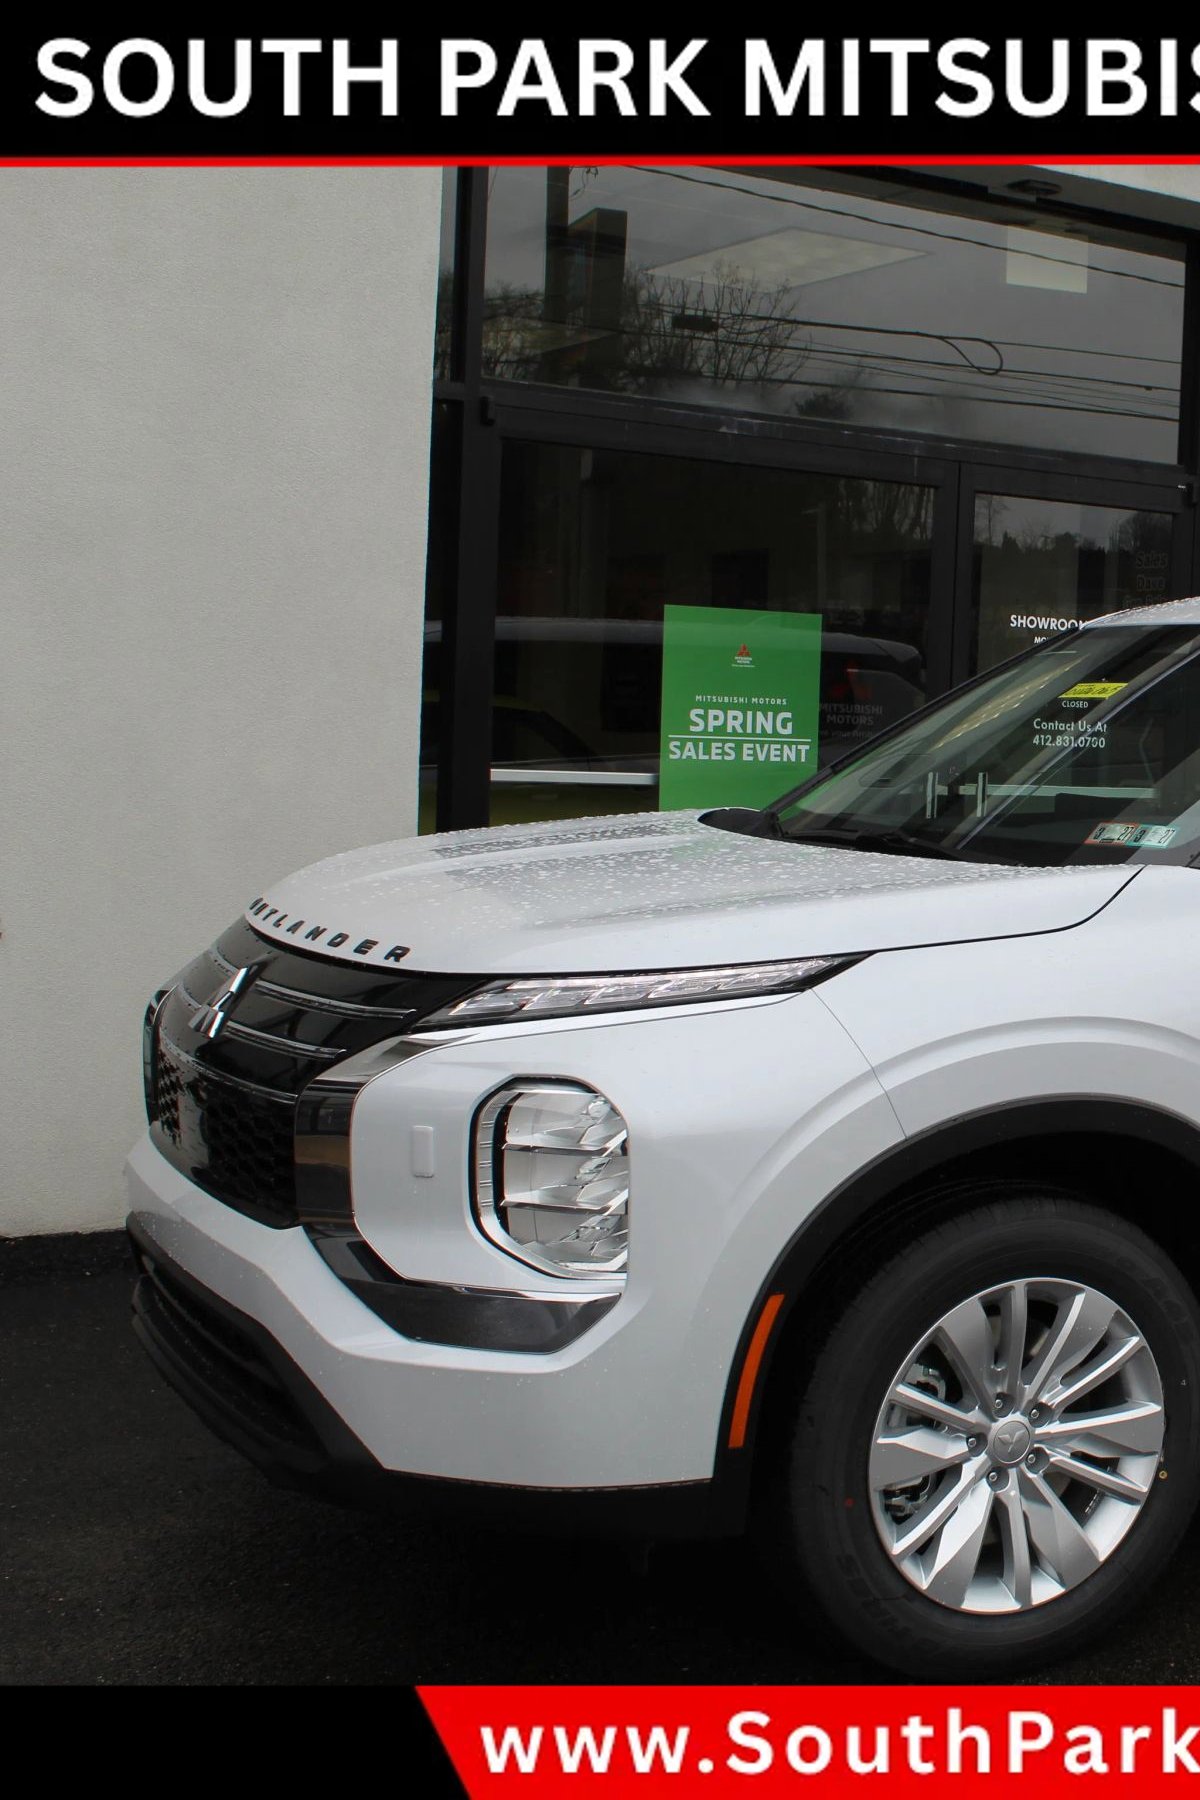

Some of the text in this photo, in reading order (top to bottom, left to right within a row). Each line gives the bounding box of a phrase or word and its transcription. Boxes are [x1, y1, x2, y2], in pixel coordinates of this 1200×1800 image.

[695, 695, 787, 706] MITSUBISHI MOTORS
[1062, 700, 1089, 709] CLOSED
[689, 708, 793, 735] SPRING
[827, 714, 874, 726] MOTORS
[1033, 718, 1107, 733] Contact Us At
[1032, 734, 1106, 748] 412.831.0700
[669, 741, 810, 763] SALES EVENT
[249, 897, 411, 962] OUTLANDER
